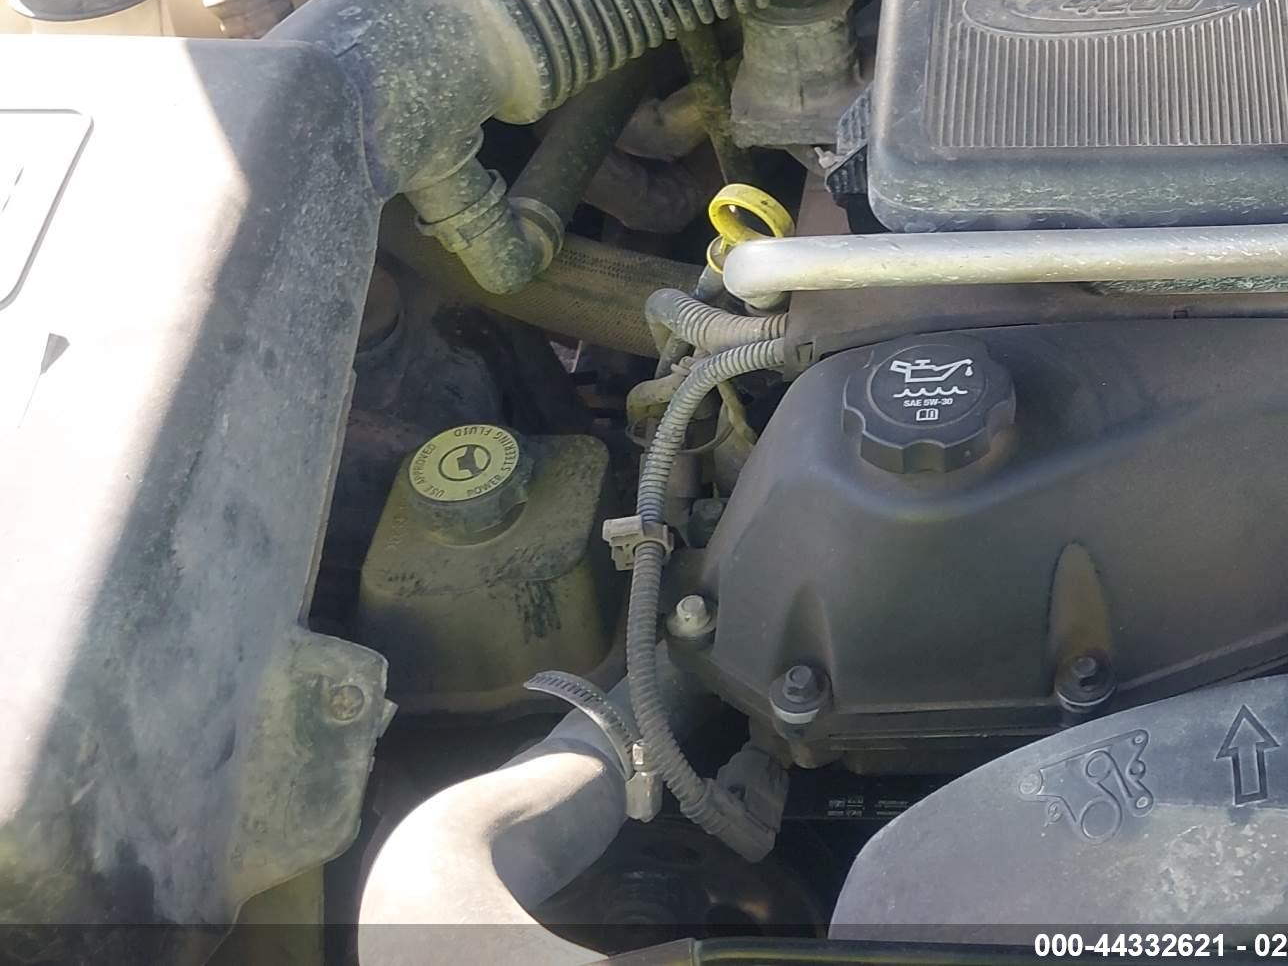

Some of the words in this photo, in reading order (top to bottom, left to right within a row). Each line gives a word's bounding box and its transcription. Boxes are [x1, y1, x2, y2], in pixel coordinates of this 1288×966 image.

[904, 399, 922, 407] SAE
[924, 398, 953, 407] 5W-30
[454, 425, 492, 437] FLUID
[492, 430, 517, 473] STEERING
[412, 442, 437, 486] APPROVED
[424, 484, 446, 498] USE
[466, 473, 504, 497] POWER
